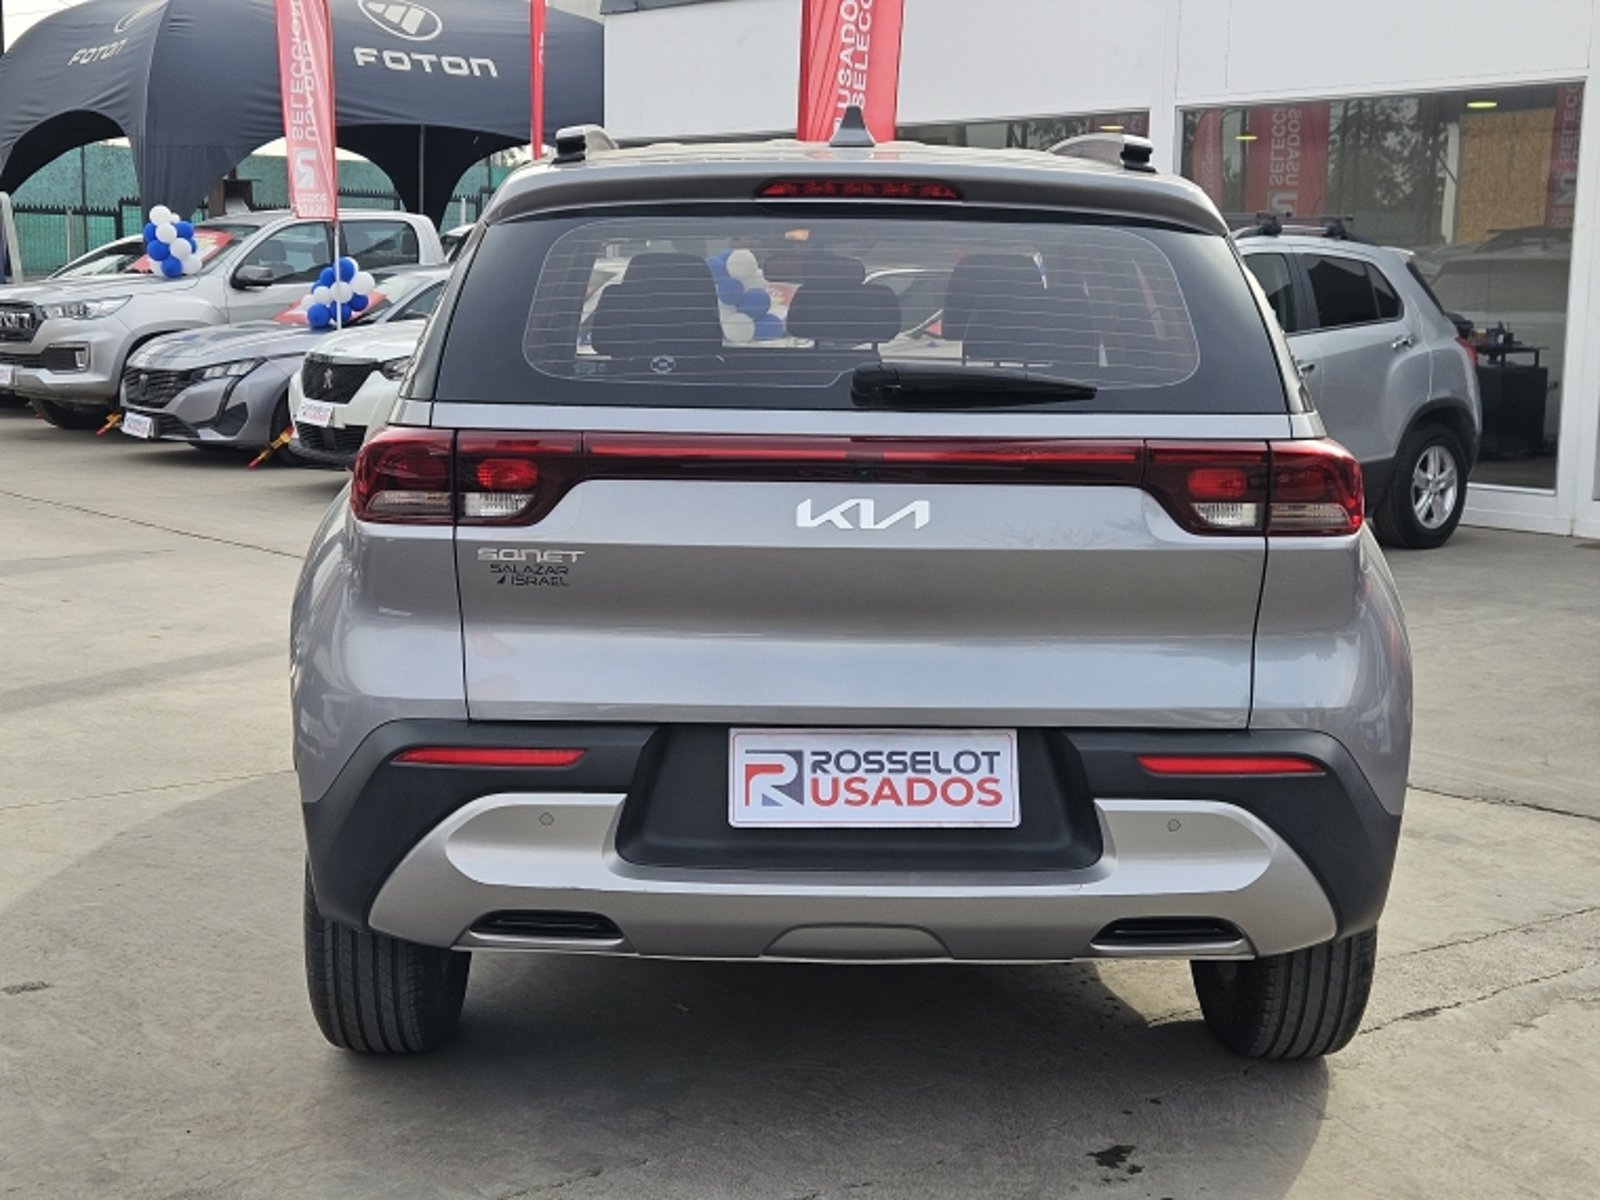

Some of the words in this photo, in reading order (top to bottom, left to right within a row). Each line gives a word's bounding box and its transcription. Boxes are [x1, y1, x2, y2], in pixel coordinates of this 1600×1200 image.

[353, 46, 498, 78] FOTON
[796, 498, 930, 530] KIA
[477, 548, 586, 563] SONET
[490, 564, 569, 575] SALAZAR
[511, 576, 569, 587] ISRAEL
[810, 750, 1001, 775] ROSSELOT
[810, 776, 1003, 807] USADOS
